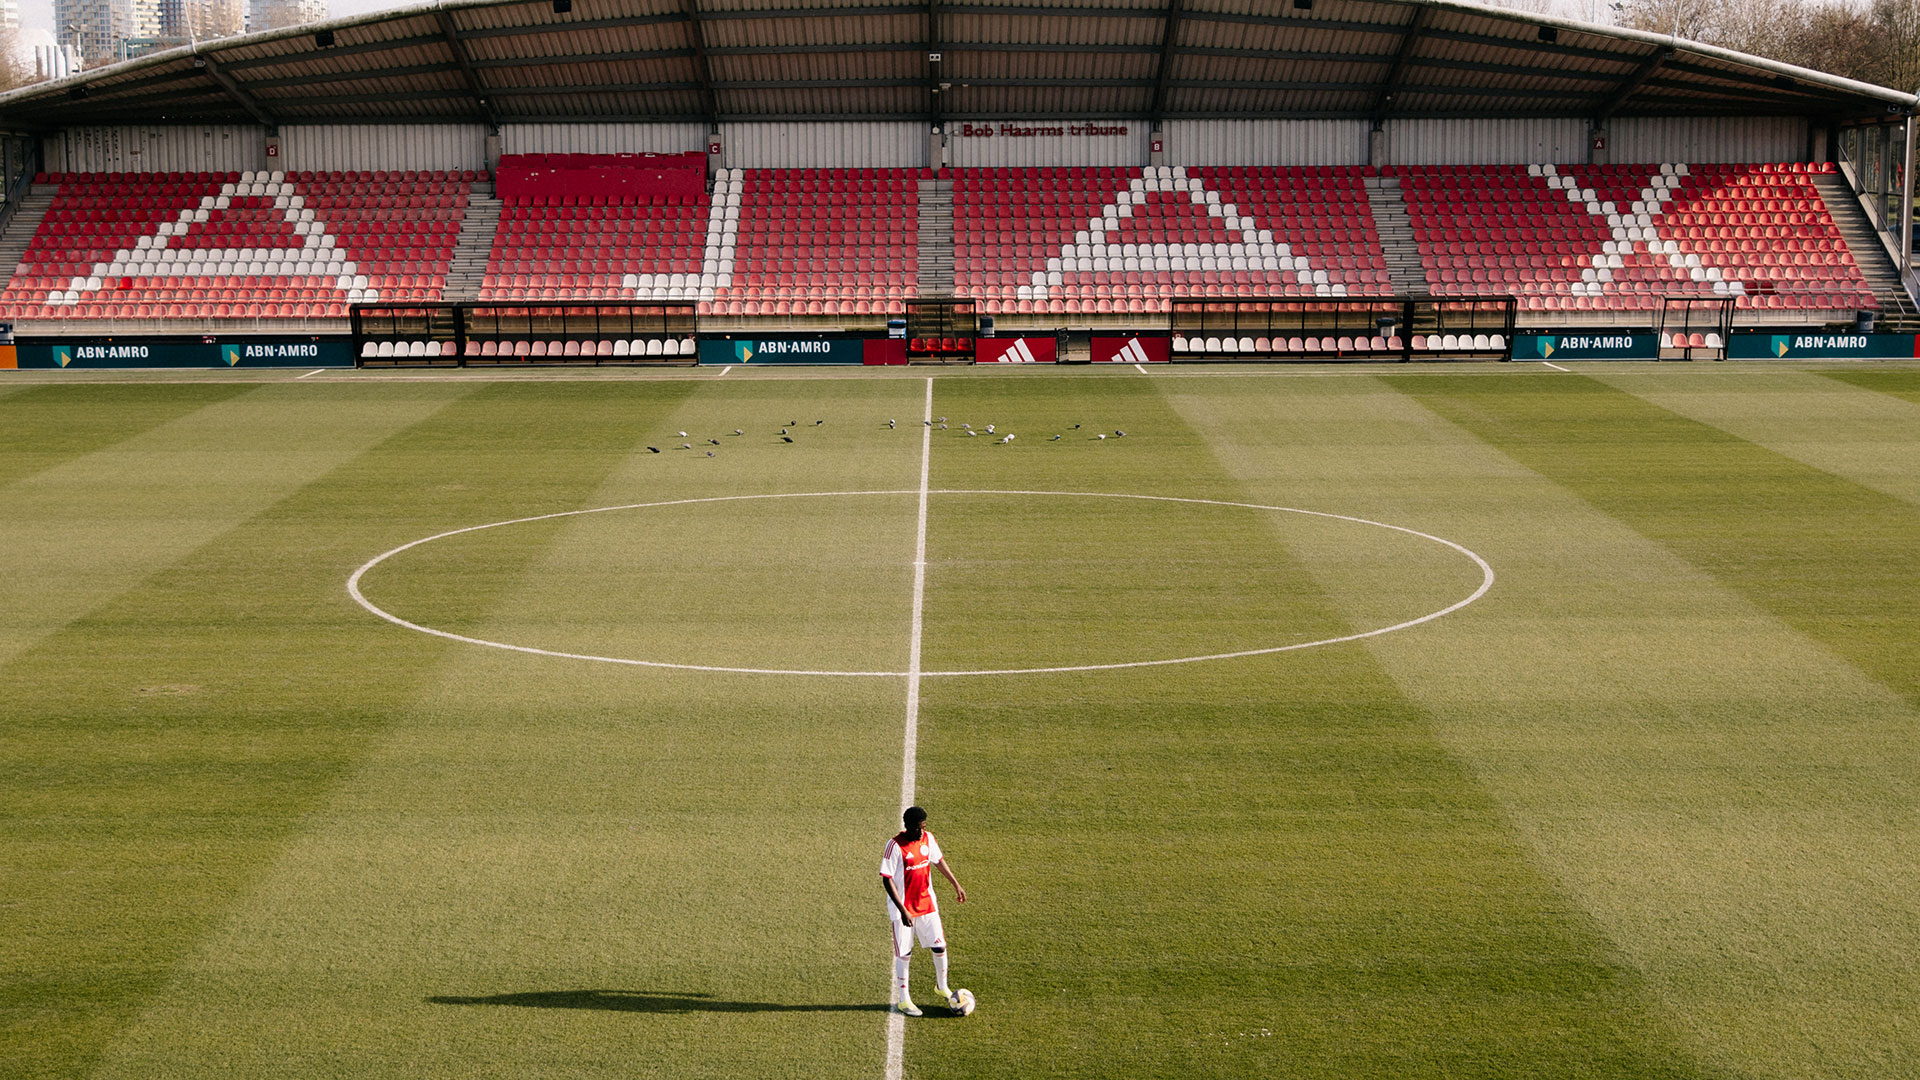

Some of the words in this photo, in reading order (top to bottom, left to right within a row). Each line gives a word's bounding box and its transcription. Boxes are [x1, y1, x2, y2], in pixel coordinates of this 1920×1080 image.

[962, 124, 994, 137] Bob
[1000, 123, 1064, 137] Haarms
[1070, 123, 1128, 136] tribune
[1154, 143, 1160, 151] B
[1595, 140, 1603, 148] A
[711, 145, 718, 153] C
